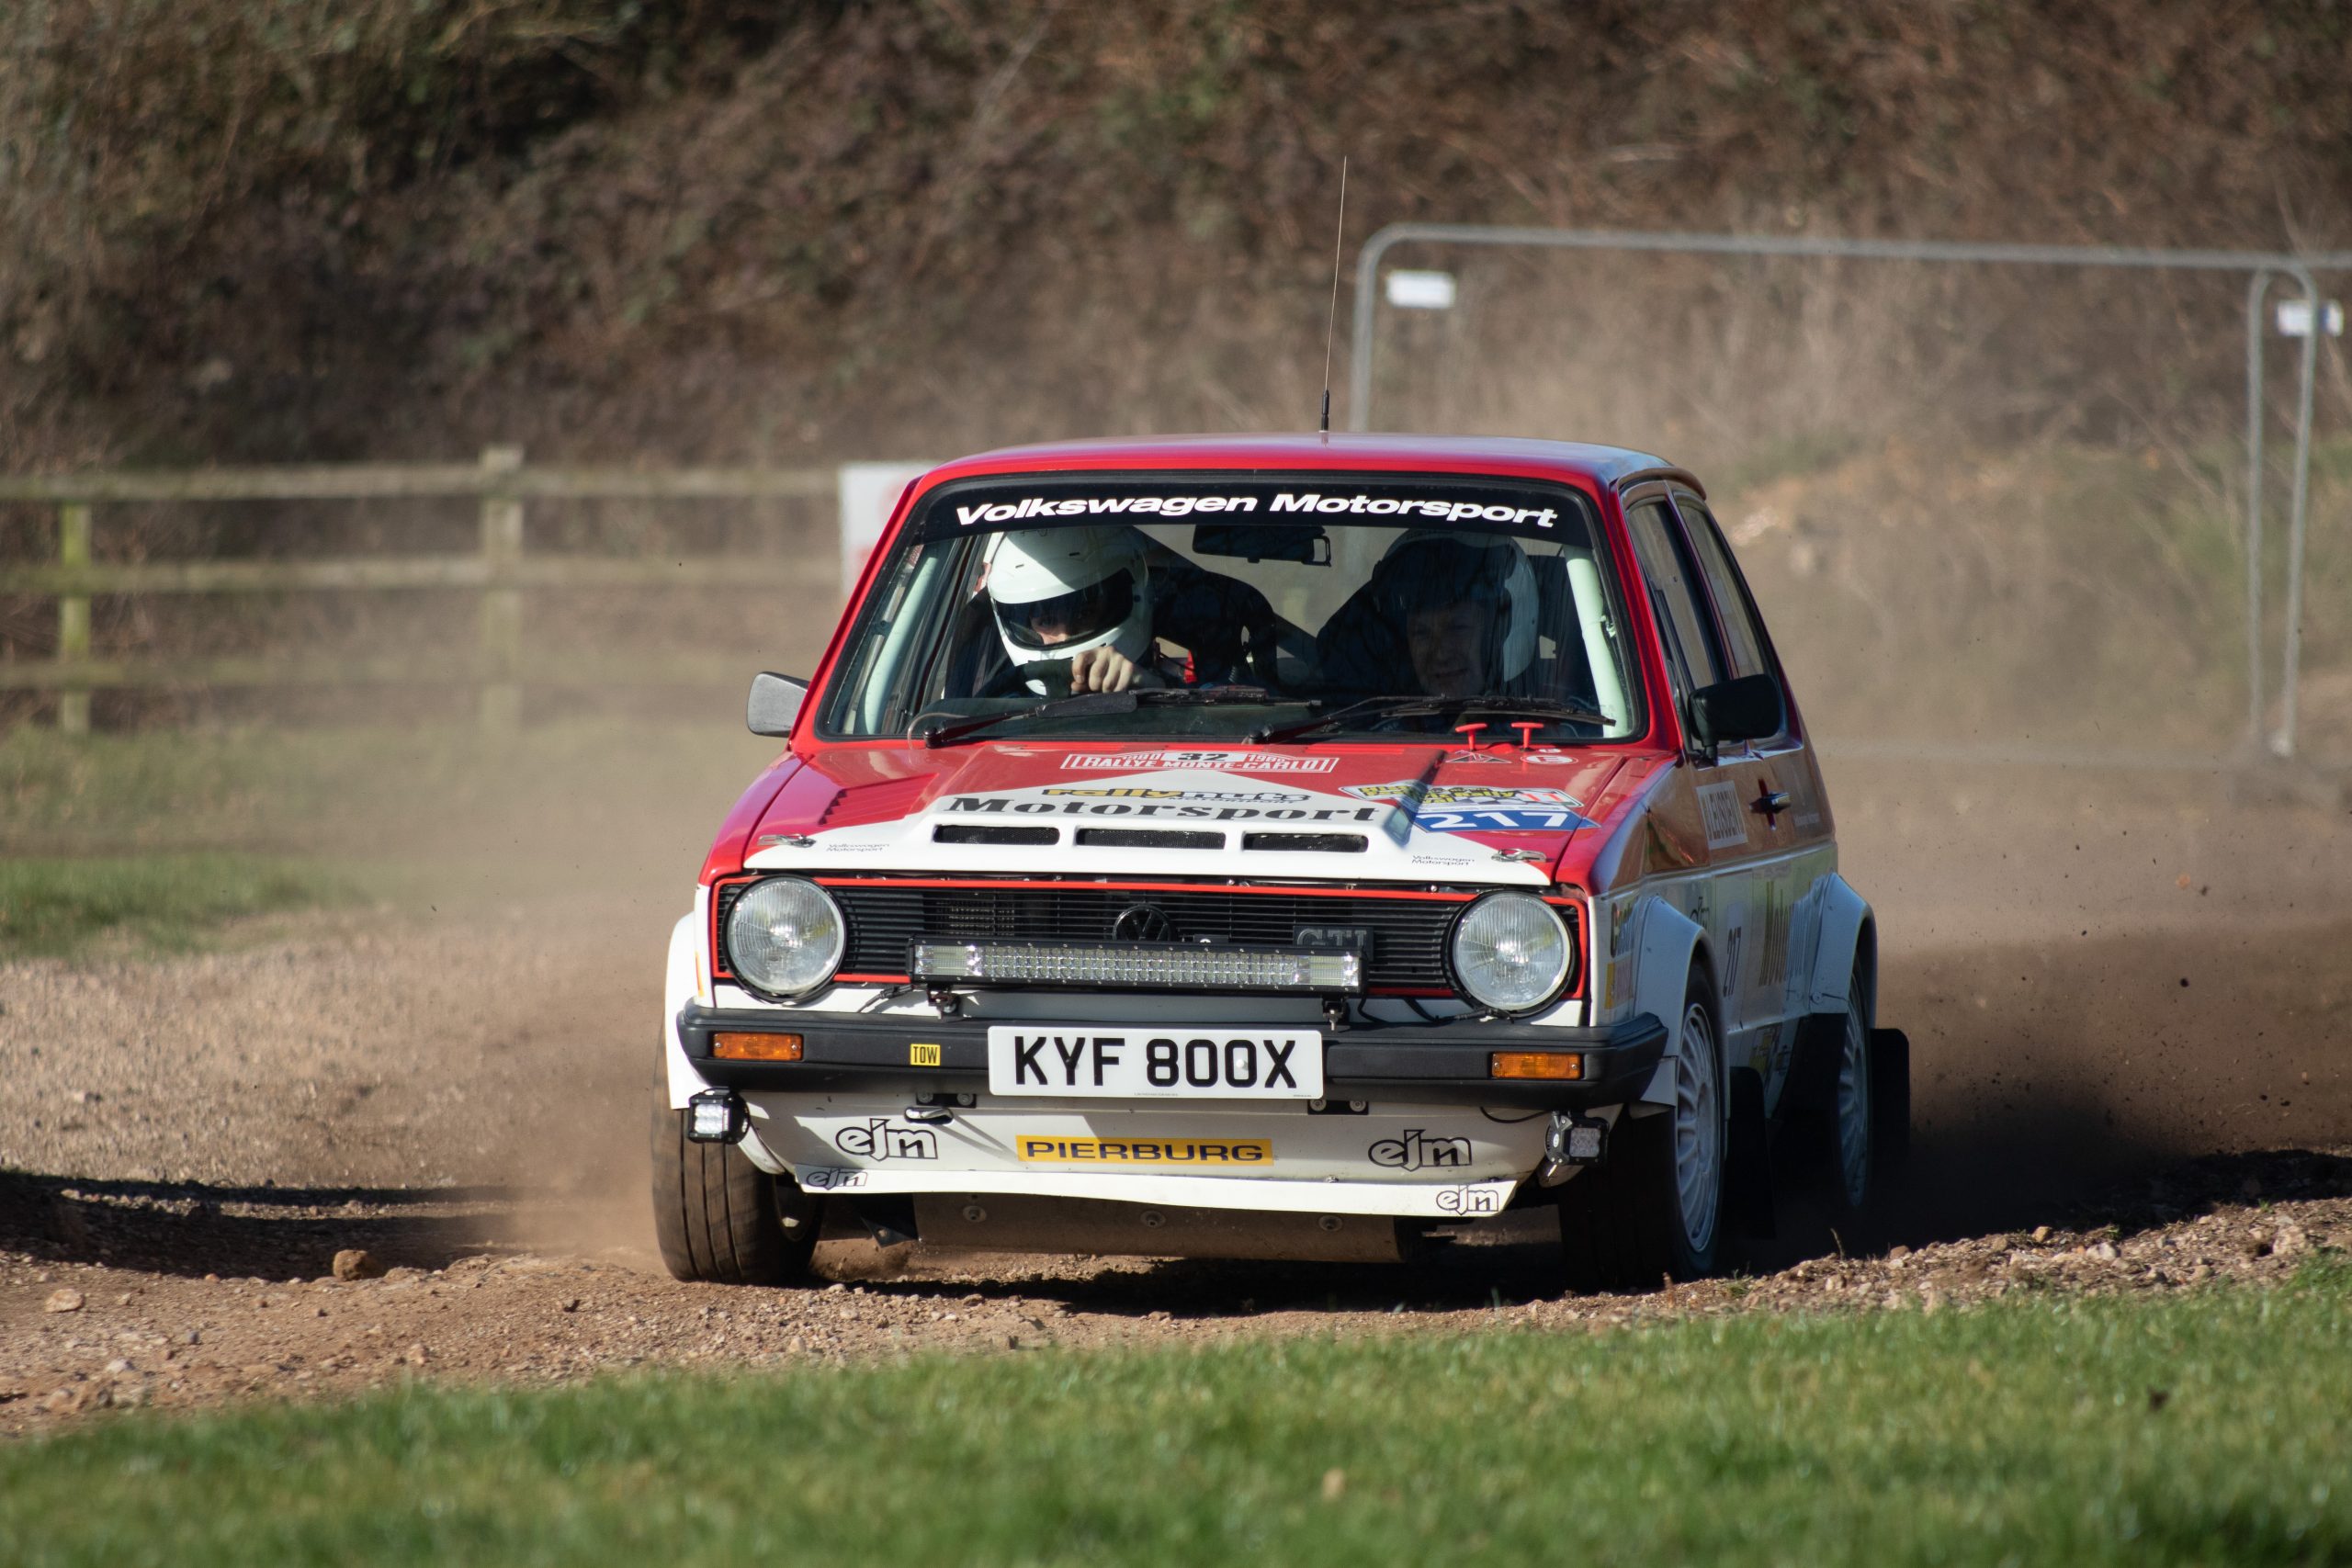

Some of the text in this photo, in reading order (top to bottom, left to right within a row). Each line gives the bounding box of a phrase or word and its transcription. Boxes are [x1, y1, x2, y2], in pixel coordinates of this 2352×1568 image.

[956, 493, 1557, 527] Volkswagen Motorsport
[1082, 756, 1157, 768] RALLYE
[1177, 752, 1229, 761] 32
[944, 796, 1380, 820] Motorsport
[1416, 812, 1568, 828] 217
[913, 1045, 938, 1064] TOW
[1014, 1035, 1297, 1089] KYF 800X
[834, 1117, 939, 1162] ejm
[1026, 1141, 1262, 1161] PIERBURG
[1367, 1129, 1473, 1172] ejm
[1435, 1184, 1499, 1215] ejm
